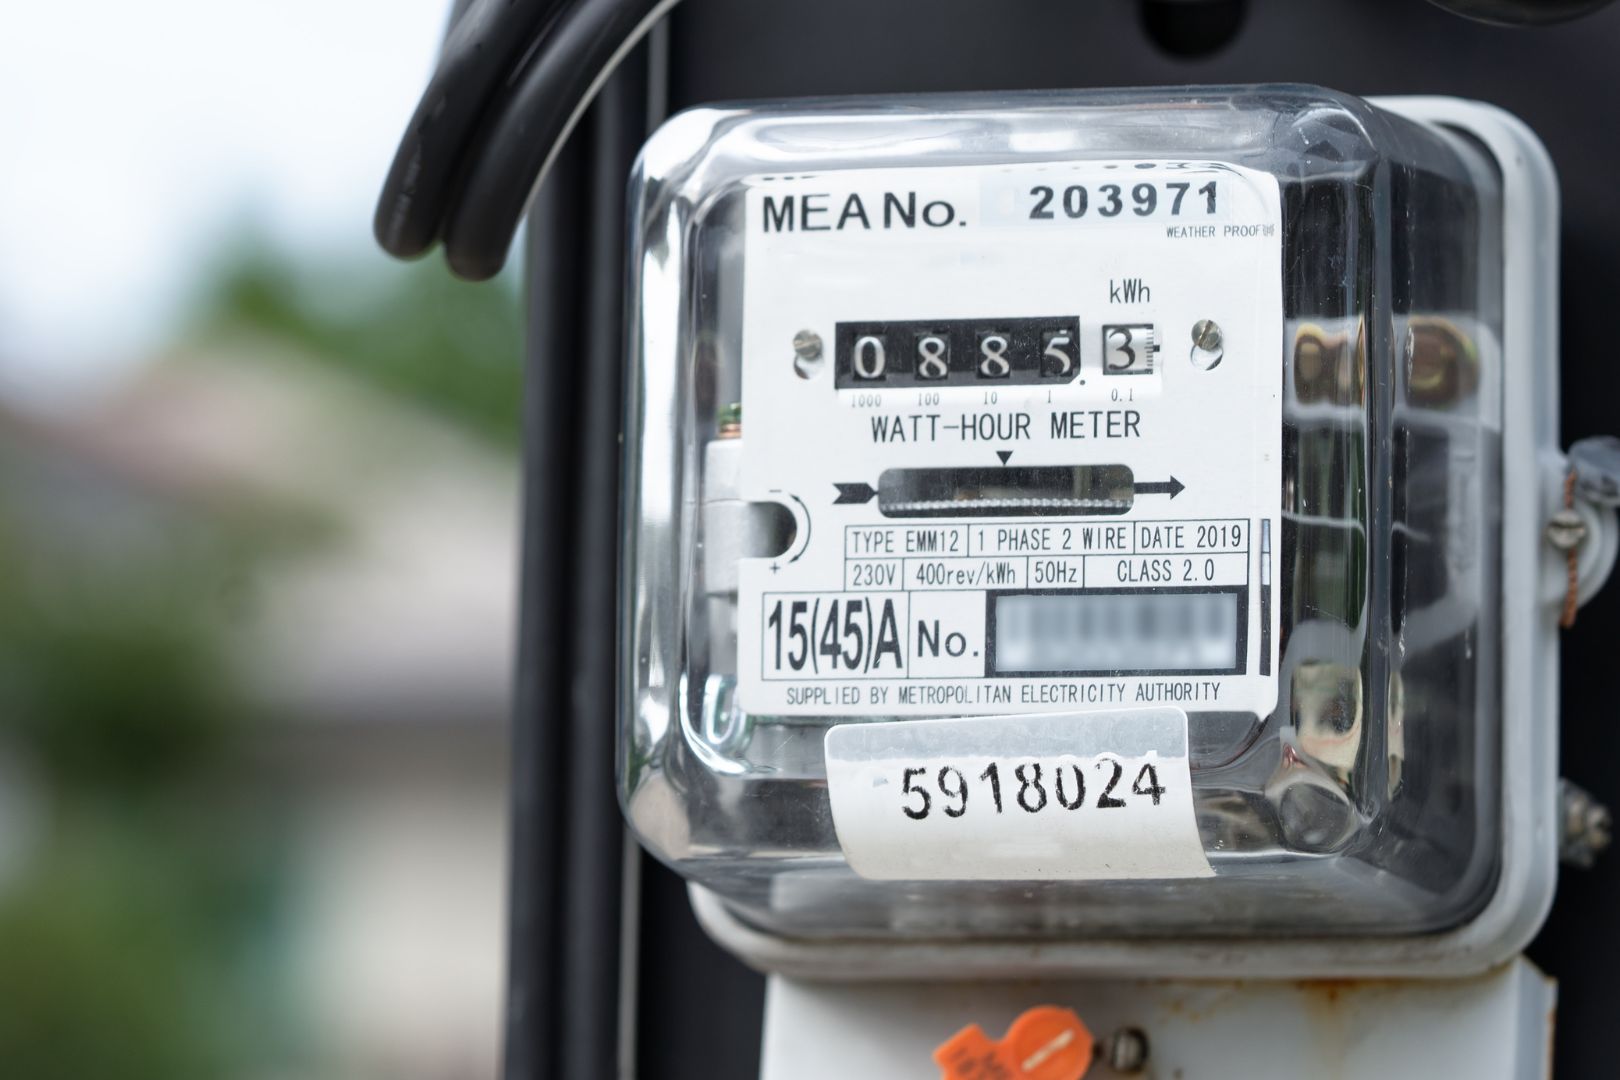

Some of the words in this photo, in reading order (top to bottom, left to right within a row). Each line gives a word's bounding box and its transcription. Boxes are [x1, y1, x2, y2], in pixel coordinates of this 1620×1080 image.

[763, 194, 871, 233] MEA
[884, 191, 967, 229] No.
[1028, 181, 1218, 220] 203971
[1166, 225, 1216, 239] WEATHER
[1109, 278, 1151, 304] kWh
[1108, 328, 1137, 371] 3
[917, 391, 940, 406] 100
[983, 391, 998, 405] 10
[1110, 387, 1134, 403] 0.1
[871, 413, 1031, 443] WATT-HOUR
[1050, 410, 1142, 440] METER
[853, 530, 894, 553] TYPE
[907, 530, 959, 551] EMM12
[979, 530, 985, 551] 1
[998, 528, 1051, 551] PHASE
[1062, 528, 1072, 550] 2
[1083, 527, 1127, 549] WIRE
[1141, 526, 1184, 548] DATE
[1197, 524, 1241, 548] 2019
[853, 564, 896, 586] 230V
[916, 562, 1016, 586] 400rev/kWh
[1035, 561, 1077, 584] 50Hz
[1117, 559, 1172, 582] CLASS
[1183, 558, 1215, 581] 2.0
[769, 596, 903, 675] 15(45)A
[917, 619, 979, 658] No.
[786, 686, 861, 706] SUPPLIED
[870, 686, 889, 705] BY
[898, 684, 1012, 705] METROPOLITAN
[1021, 683, 1126, 703] ELECTRICITY
[1135, 681, 1221, 701] AUTHORITY
[901, 757, 1167, 820] 5918024
